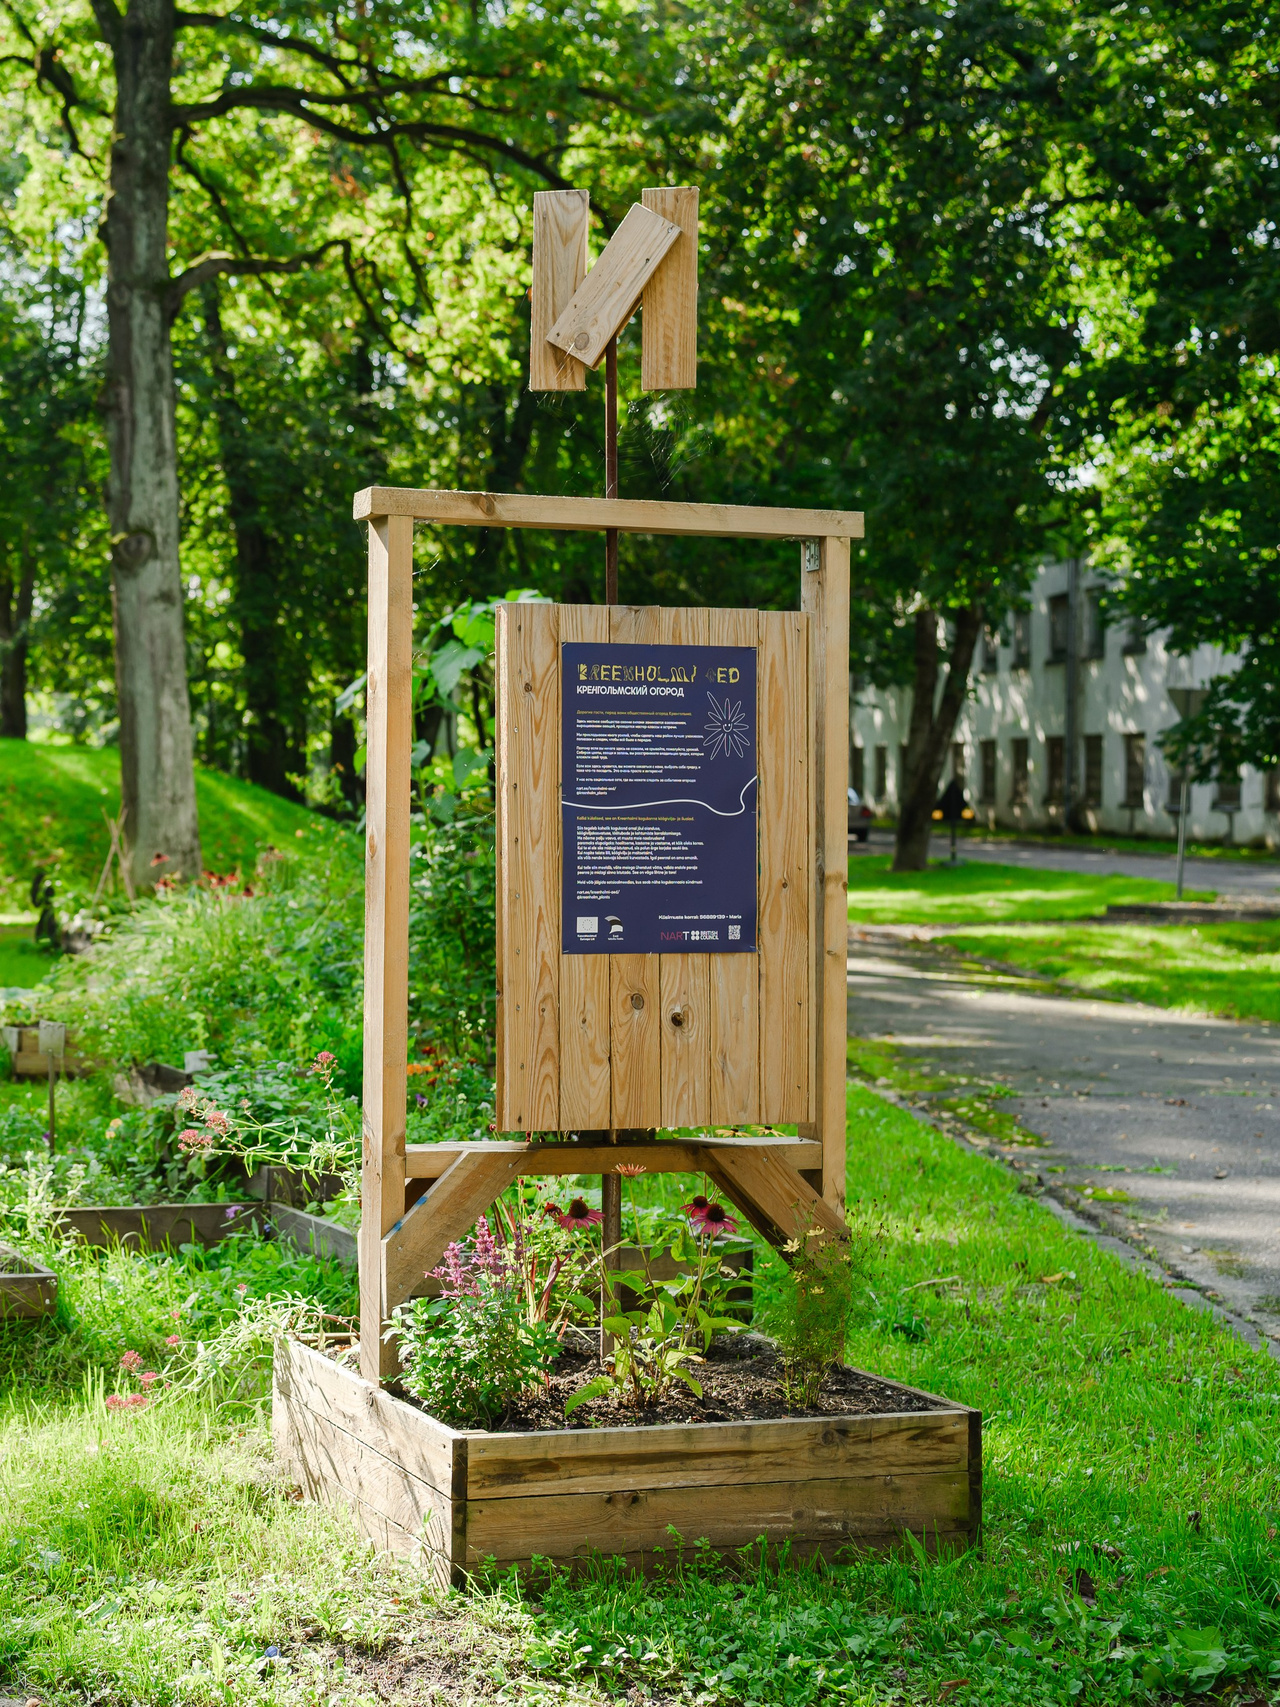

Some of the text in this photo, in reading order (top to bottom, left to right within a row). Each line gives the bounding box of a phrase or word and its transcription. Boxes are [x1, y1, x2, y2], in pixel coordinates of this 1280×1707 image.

[576, 684, 684, 697] КРЕНГОЛЬМСКИЙ ОГОРОД
[660, 931, 689, 941] NART
